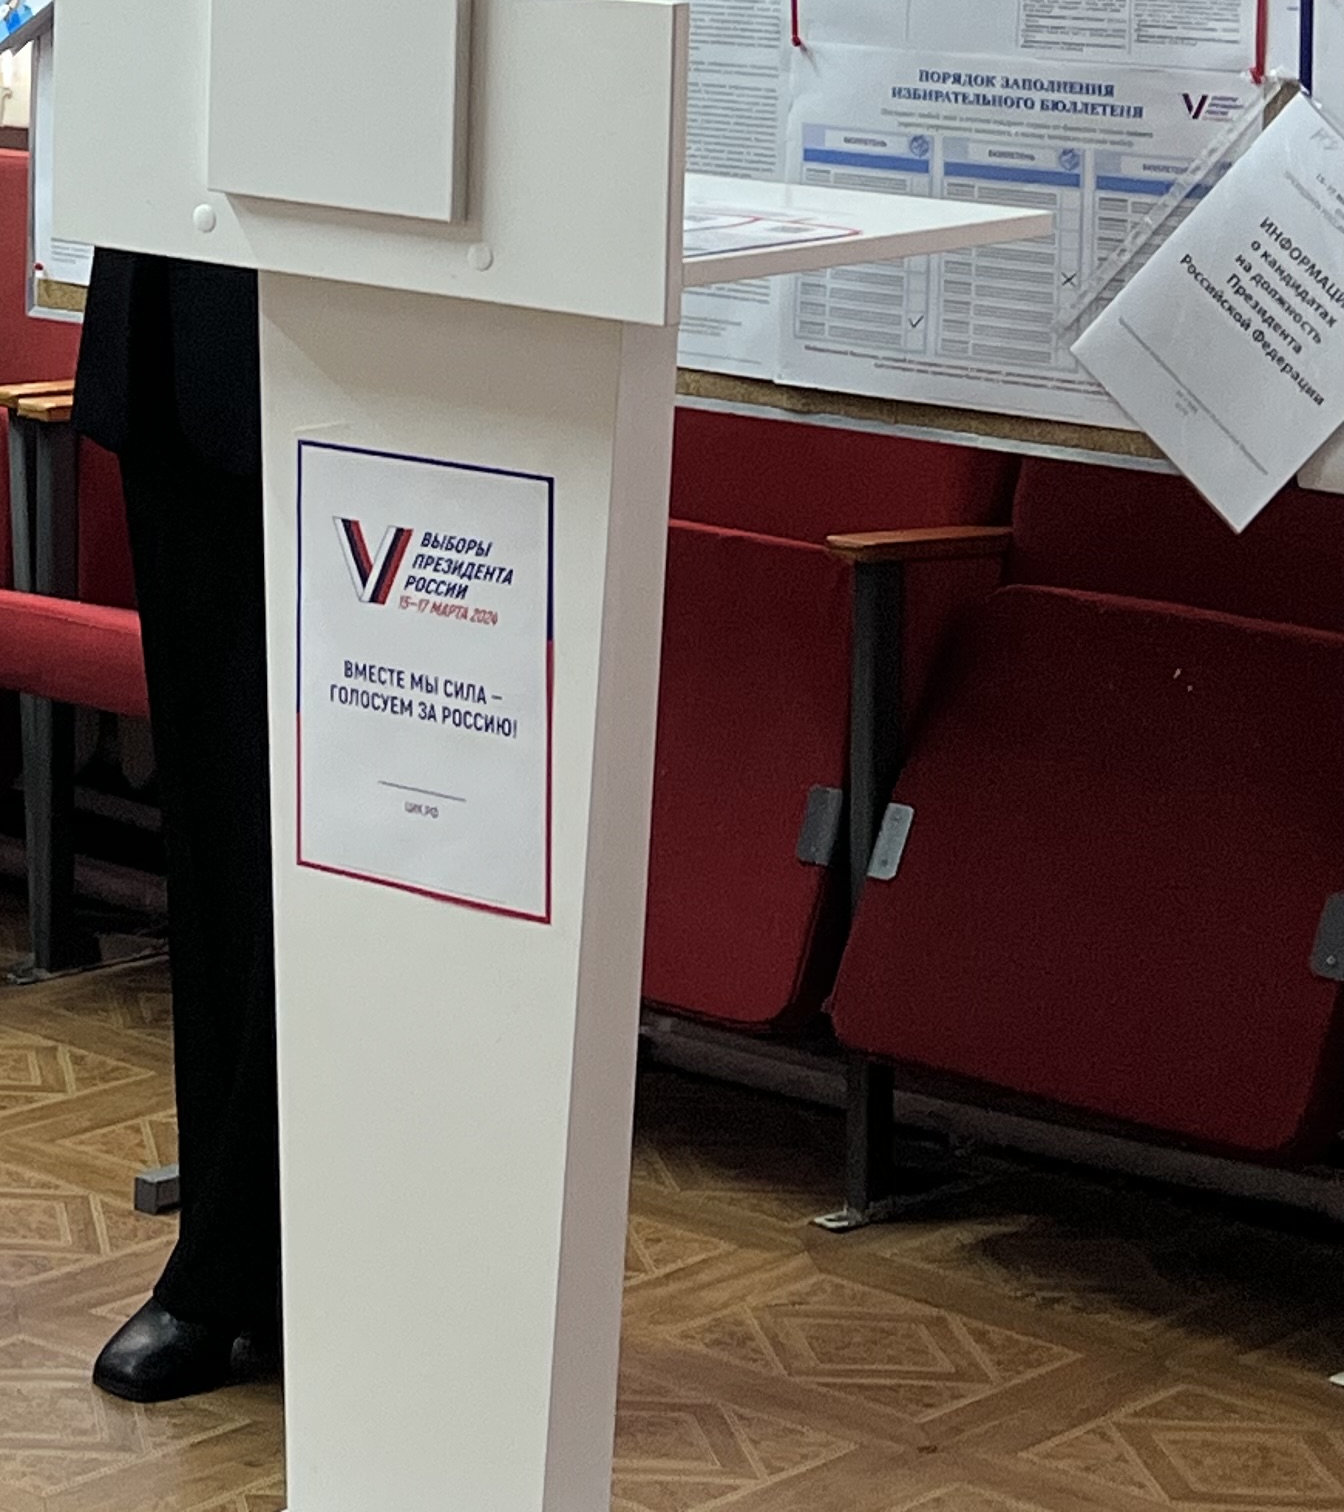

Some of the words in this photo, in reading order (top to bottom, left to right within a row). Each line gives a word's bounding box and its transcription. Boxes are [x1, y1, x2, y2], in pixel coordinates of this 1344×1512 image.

[891, 86, 1035, 112] ИЗБИРАТЕЛЬНОГО
[1039, 97, 1145, 119] БЮЛЛЕТЕНЯ
[918, 68, 998, 90] ПОРЯДОК
[1000, 75, 1115, 98] ЗАПОЛНЕНИЯ
[1235, 253, 1254, 276] на
[1252, 271, 1324, 345] должность
[1250, 240, 1261, 252] о
[1261, 249, 1339, 329] кандидатах
[1180, 253, 1254, 333] Российской
[1252, 328, 1325, 407] Федерации
[1226, 272, 1304, 355] Президента
[420, 531, 493, 557] ВЫБОРЫ
[403, 575, 469, 600] РОССИИ
[412, 553, 514, 586] ПРЕЗИДЕНТА
[429, 603, 468, 620] МАРТА
[470, 608, 499, 627] 2024
[343, 659, 405, 689] ВМЕСТЕ
[410, 672, 439, 695] МЫ
[443, 679, 487, 705] СИЛА
[330, 684, 413, 718] ГОЛОСУЕМ
[417, 702, 437, 723] ЗА
[441, 706, 518, 739] РОССИЮ!
